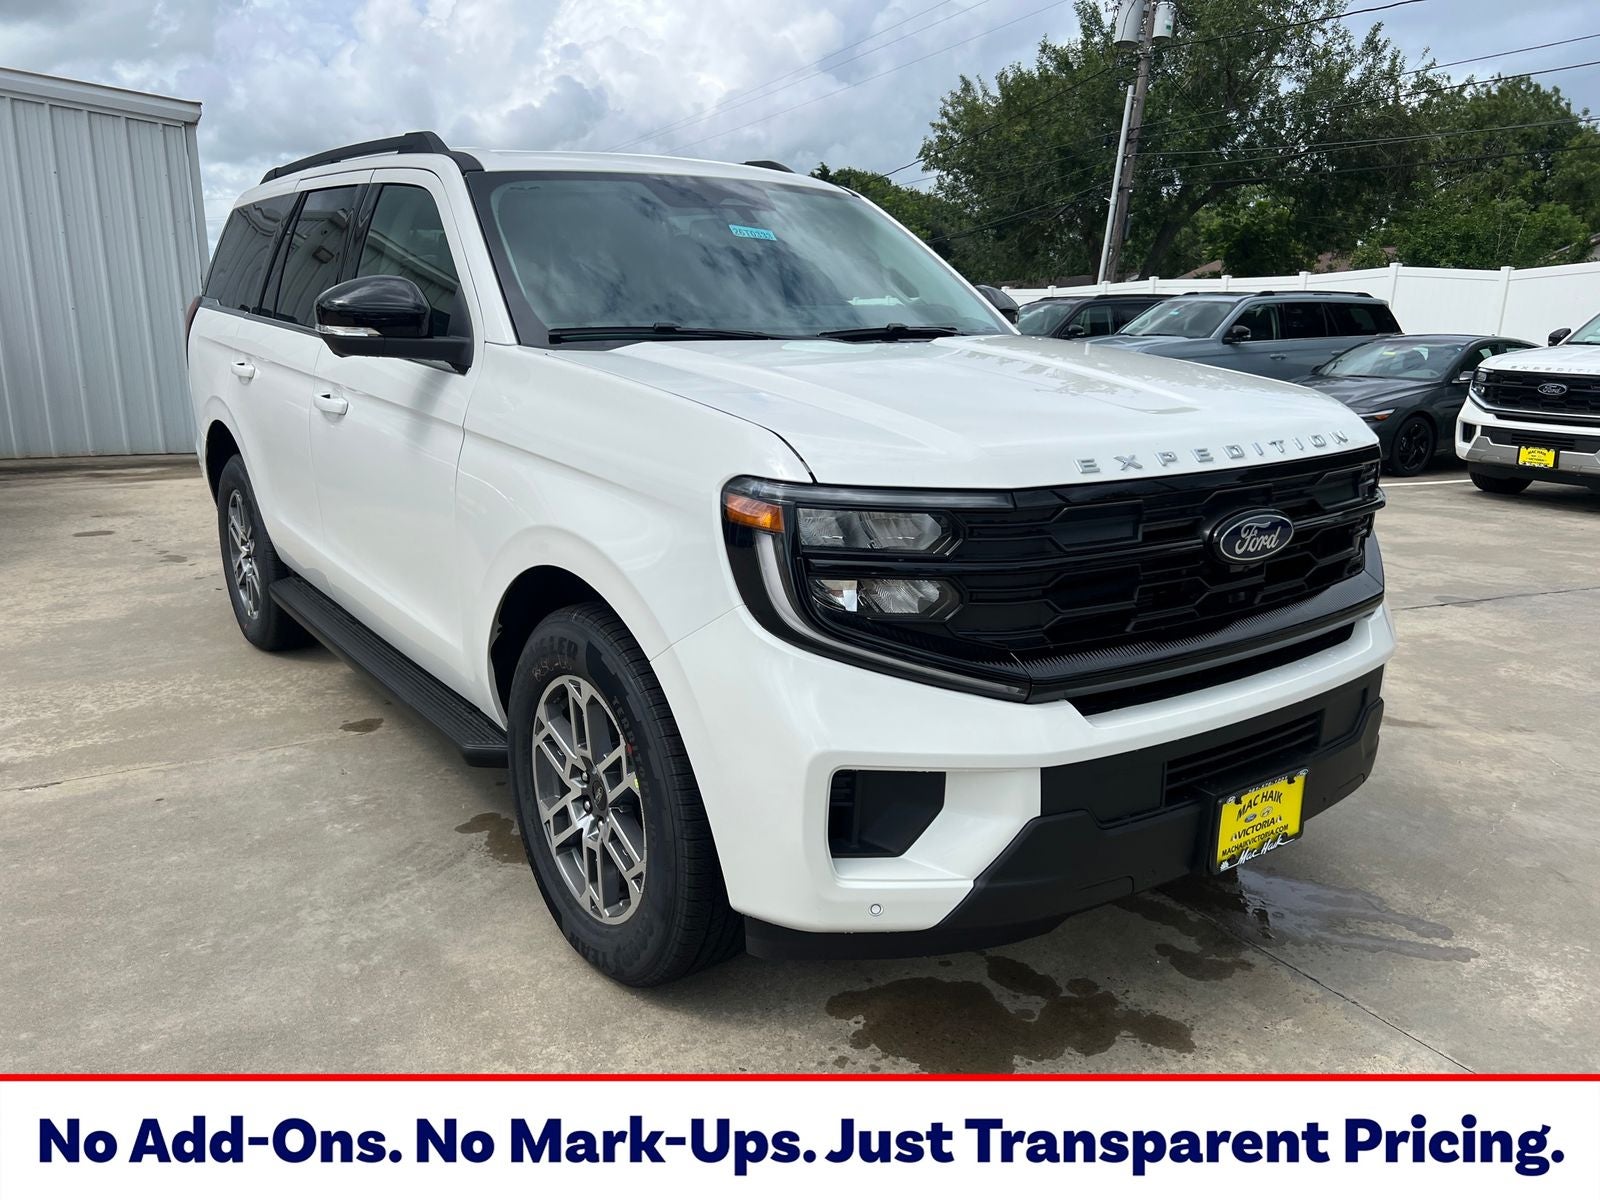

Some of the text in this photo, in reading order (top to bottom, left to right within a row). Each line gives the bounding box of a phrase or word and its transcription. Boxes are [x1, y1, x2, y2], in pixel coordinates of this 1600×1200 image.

[1073, 430, 1349, 474] EXPEDITION
[1235, 521, 1282, 555] Ford
[1236, 790, 1283, 821] MAC HAIK
[1221, 824, 1289, 857] MACHAIKVICTORIA.COM
[1237, 817, 1275, 839] VICTORIA
[1238, 847, 1259, 864] Mac
